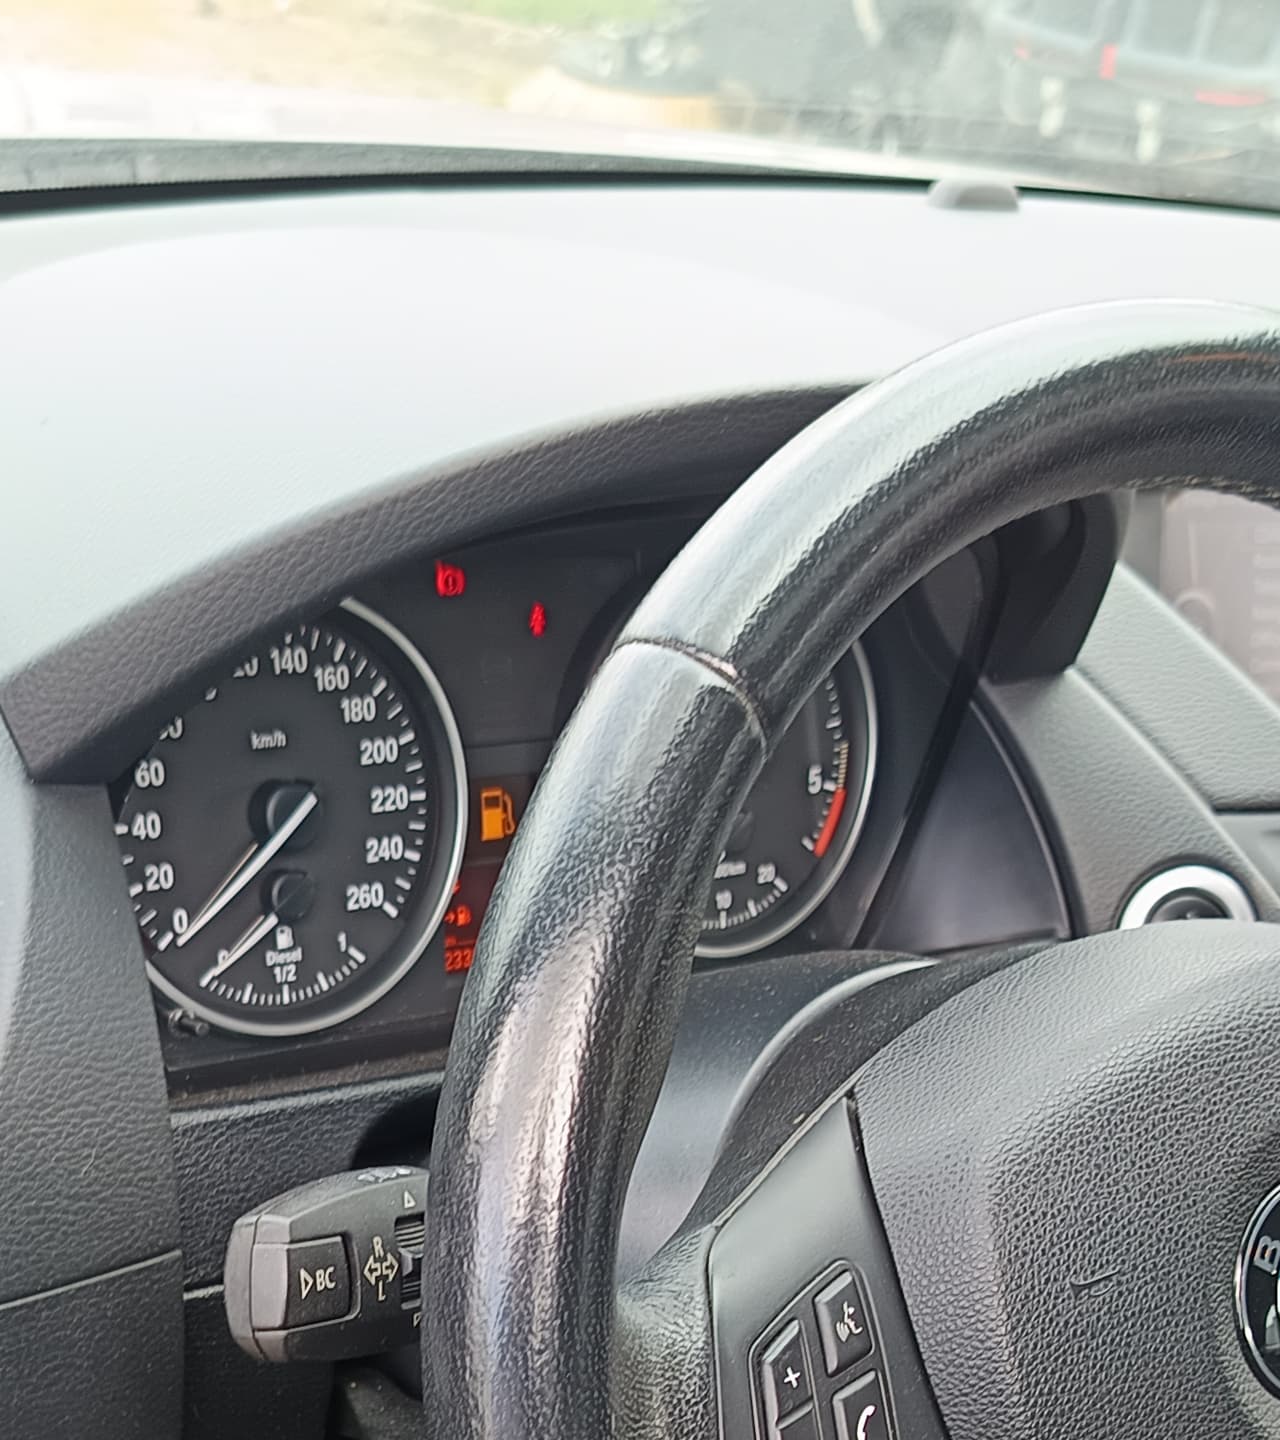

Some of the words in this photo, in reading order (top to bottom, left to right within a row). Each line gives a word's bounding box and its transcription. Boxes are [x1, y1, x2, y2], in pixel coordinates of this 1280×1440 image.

[271, 646, 308, 675] 140
[314, 665, 350, 692] 160
[340, 696, 376, 723] 180
[250, 729, 287, 750] km/h
[360, 739, 399, 766] 200
[134, 757, 165, 789] 60
[808, 764, 823, 795] 5
[371, 784, 409, 813] 220
[132, 812, 162, 840] 40
[365, 834, 404, 864] 240
[144, 863, 174, 892] 20
[346, 881, 384, 912] 260
[172, 907, 189, 934] 0
[337, 931, 348, 953] 1
[266, 947, 303, 966] Diesel
[273, 965, 298, 984] 1/2
[373, 1235, 385, 1259] R
[315, 1266, 337, 1292] BC
[377, 1280, 386, 1302] L
